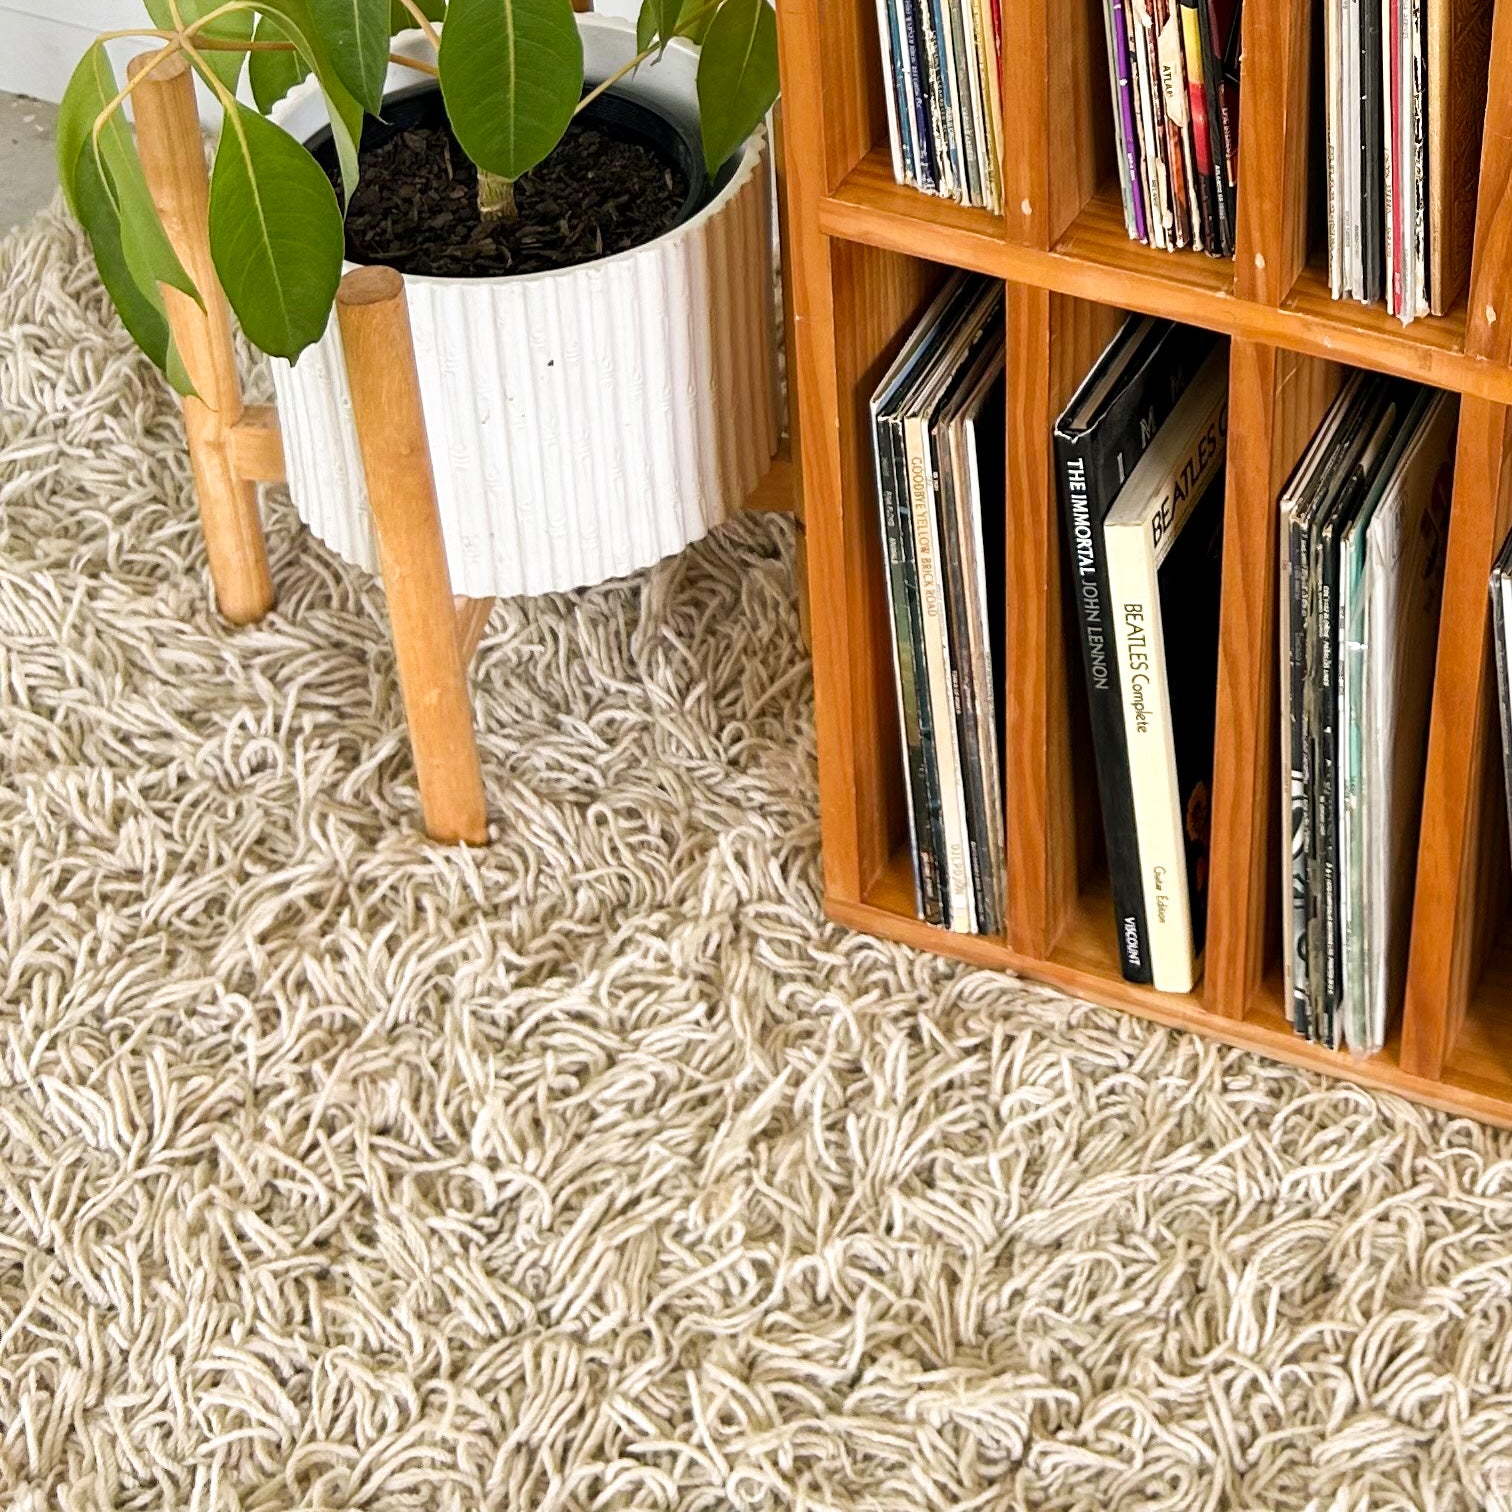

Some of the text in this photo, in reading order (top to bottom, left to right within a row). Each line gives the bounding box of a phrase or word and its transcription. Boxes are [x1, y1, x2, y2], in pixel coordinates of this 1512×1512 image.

[911, 456, 938, 616] GOODBYE YELLOW BRICK ROAD
[1152, 432, 1216, 548] BEATLES
[1067, 458, 1109, 689] THE IMMORTAL JOHN LENNON
[1124, 604, 1153, 734] BEATLES Complete
[1124, 917, 1140, 966] VISCOUNT
